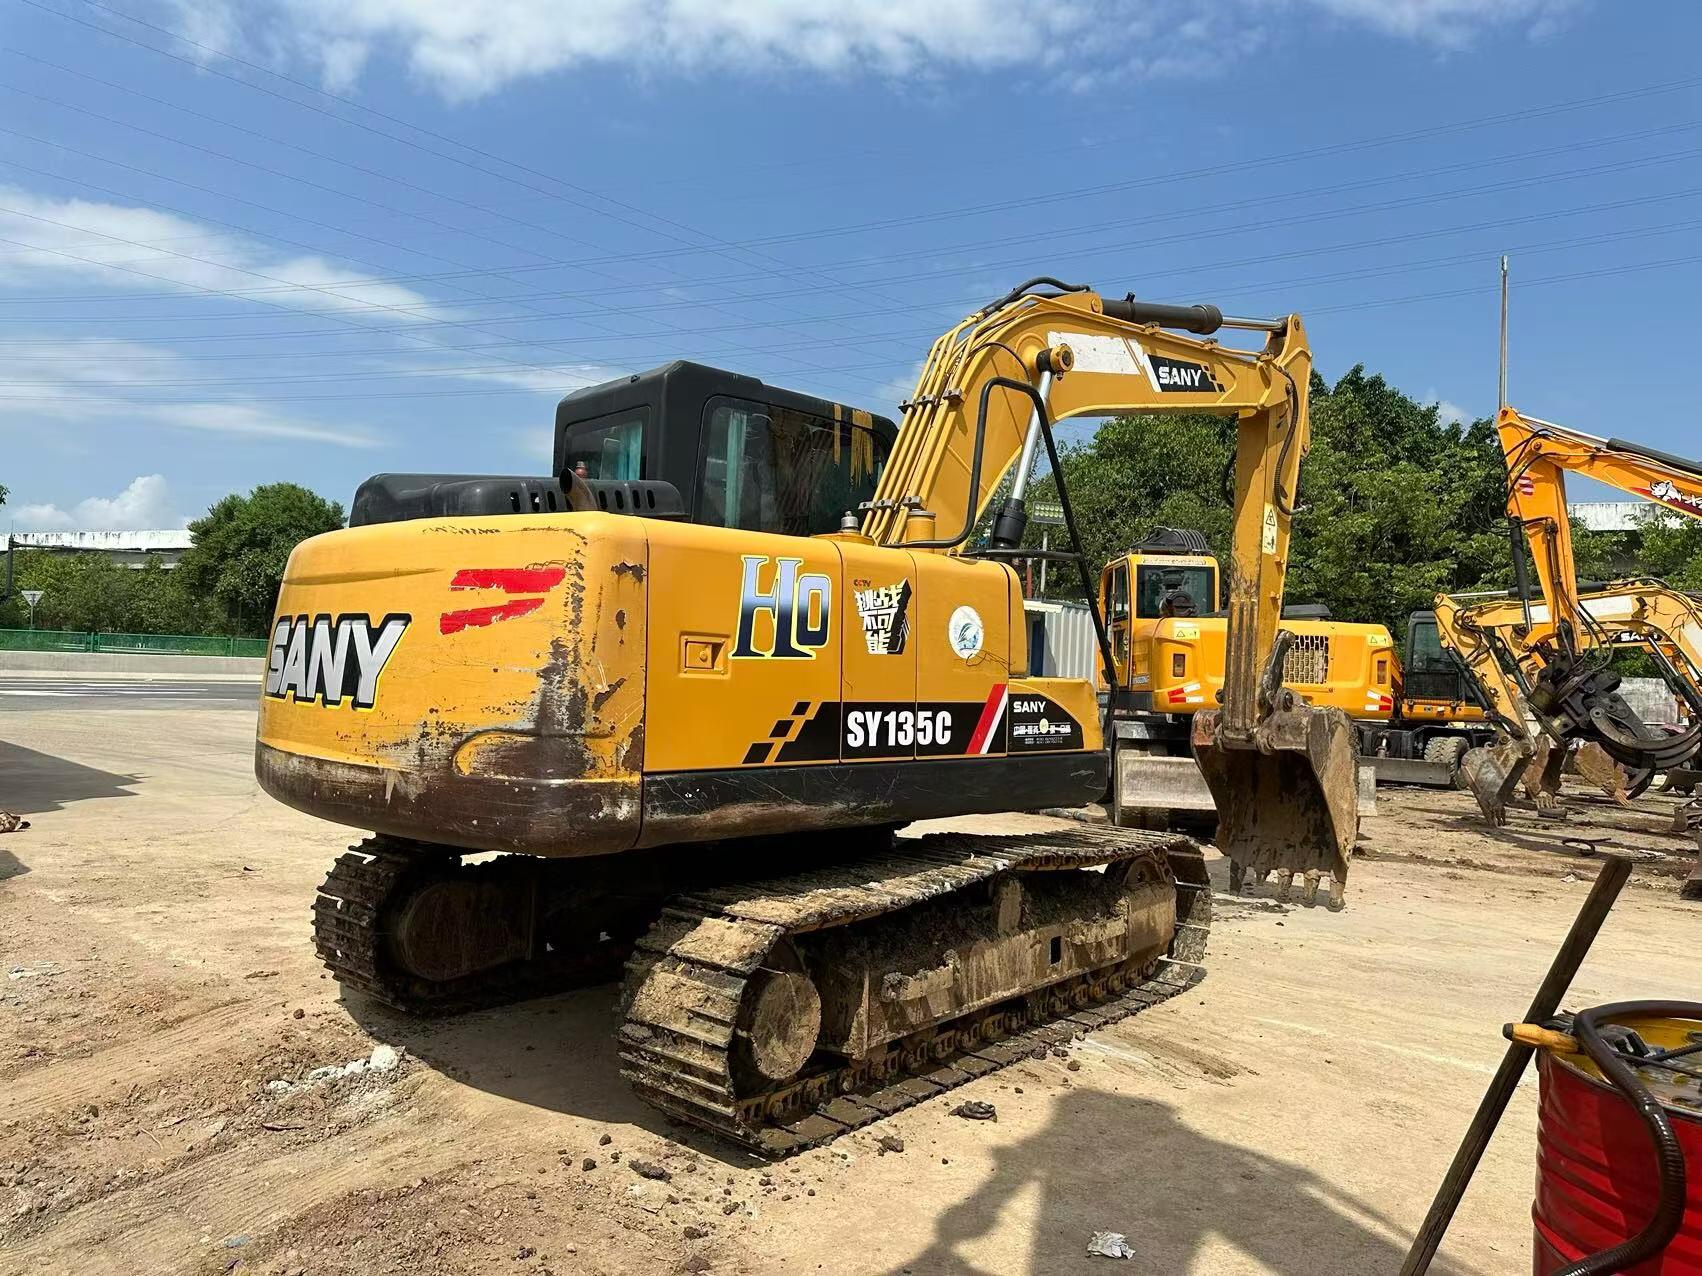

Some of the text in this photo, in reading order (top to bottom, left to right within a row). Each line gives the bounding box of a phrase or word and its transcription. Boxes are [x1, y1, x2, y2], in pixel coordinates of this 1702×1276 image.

[1158, 366, 1202, 387] SANY
[265, 613, 412, 710] SANY
[1013, 701, 1046, 713] SANY
[846, 711, 952, 748] SY135C
